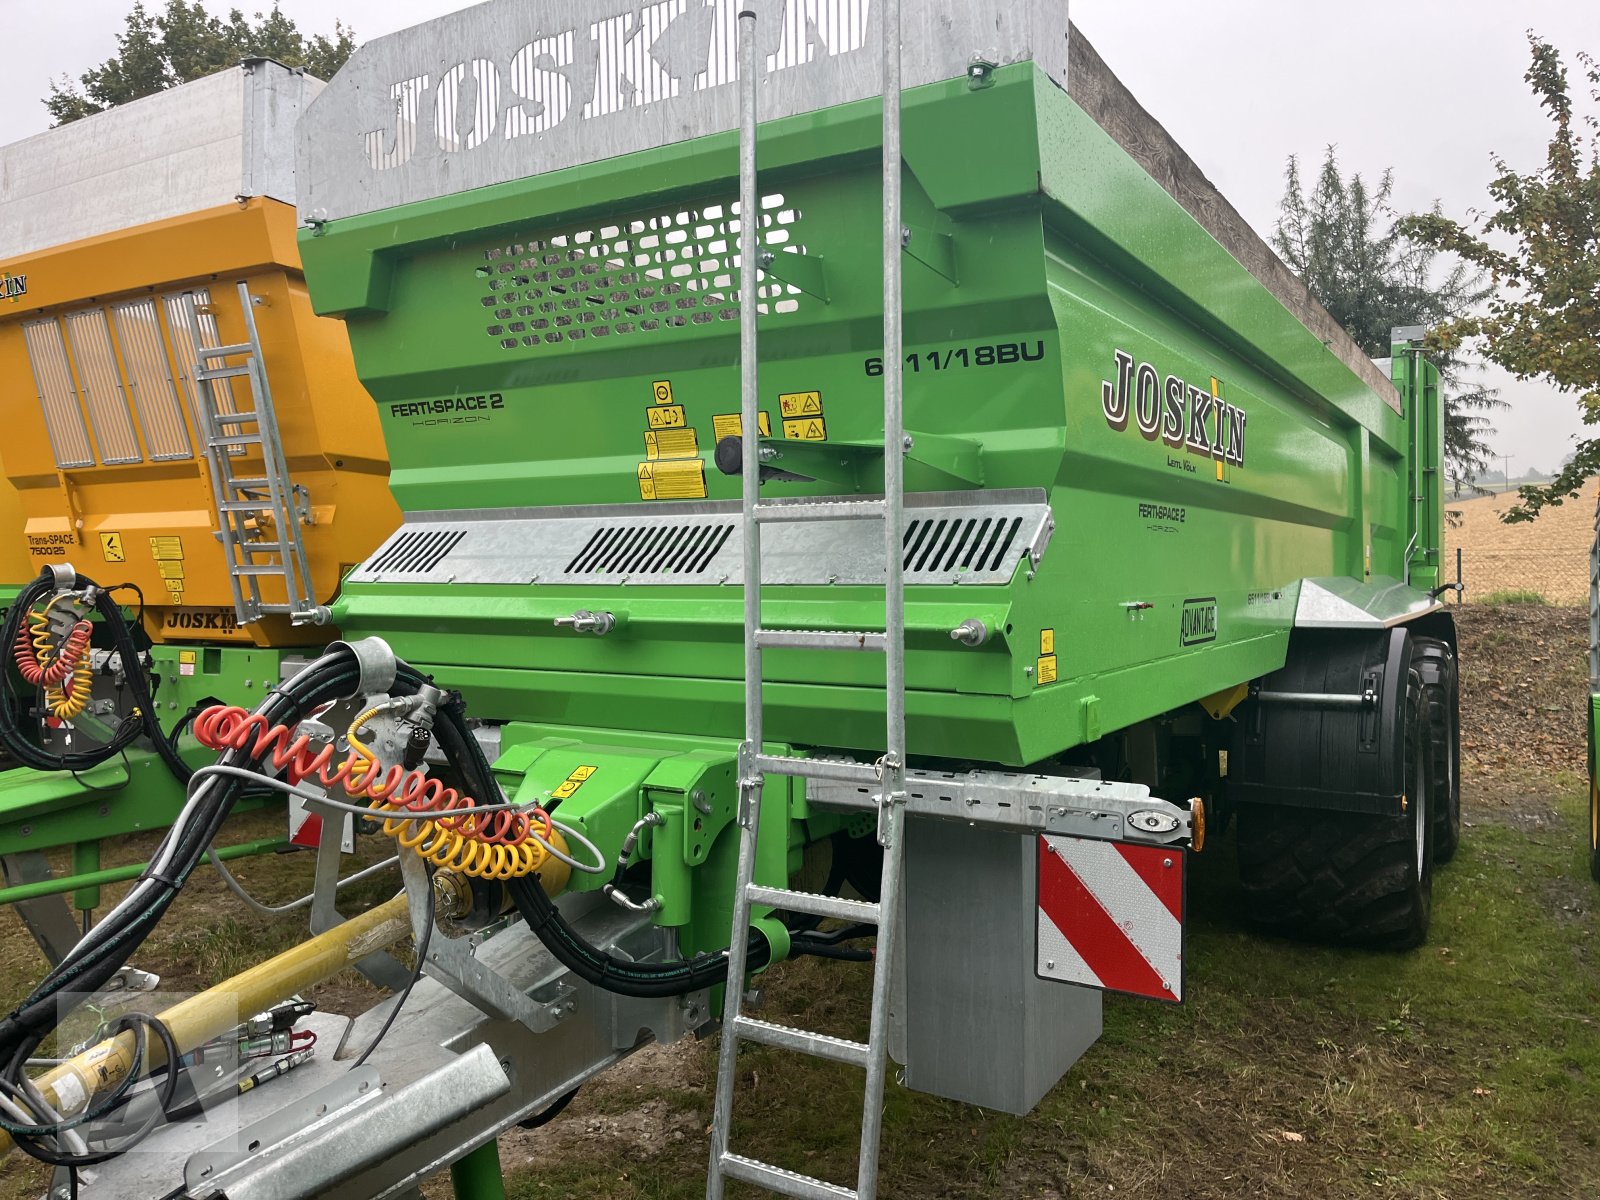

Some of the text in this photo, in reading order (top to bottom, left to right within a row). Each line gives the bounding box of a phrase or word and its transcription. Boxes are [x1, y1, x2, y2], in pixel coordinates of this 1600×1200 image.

[0, 275, 27, 299] IN
[865, 341, 1045, 377] 611/18BU
[391, 393, 504, 417] FERTI-SPACE 2
[1102, 348, 1246, 468] JOSKIN
[413, 415, 490, 427] HORIZON
[1139, 503, 1186, 523] FERTI-SPACE 2
[28, 534, 74, 545] Trans-SPACE
[1180, 605, 1215, 647] ADVANTAGE
